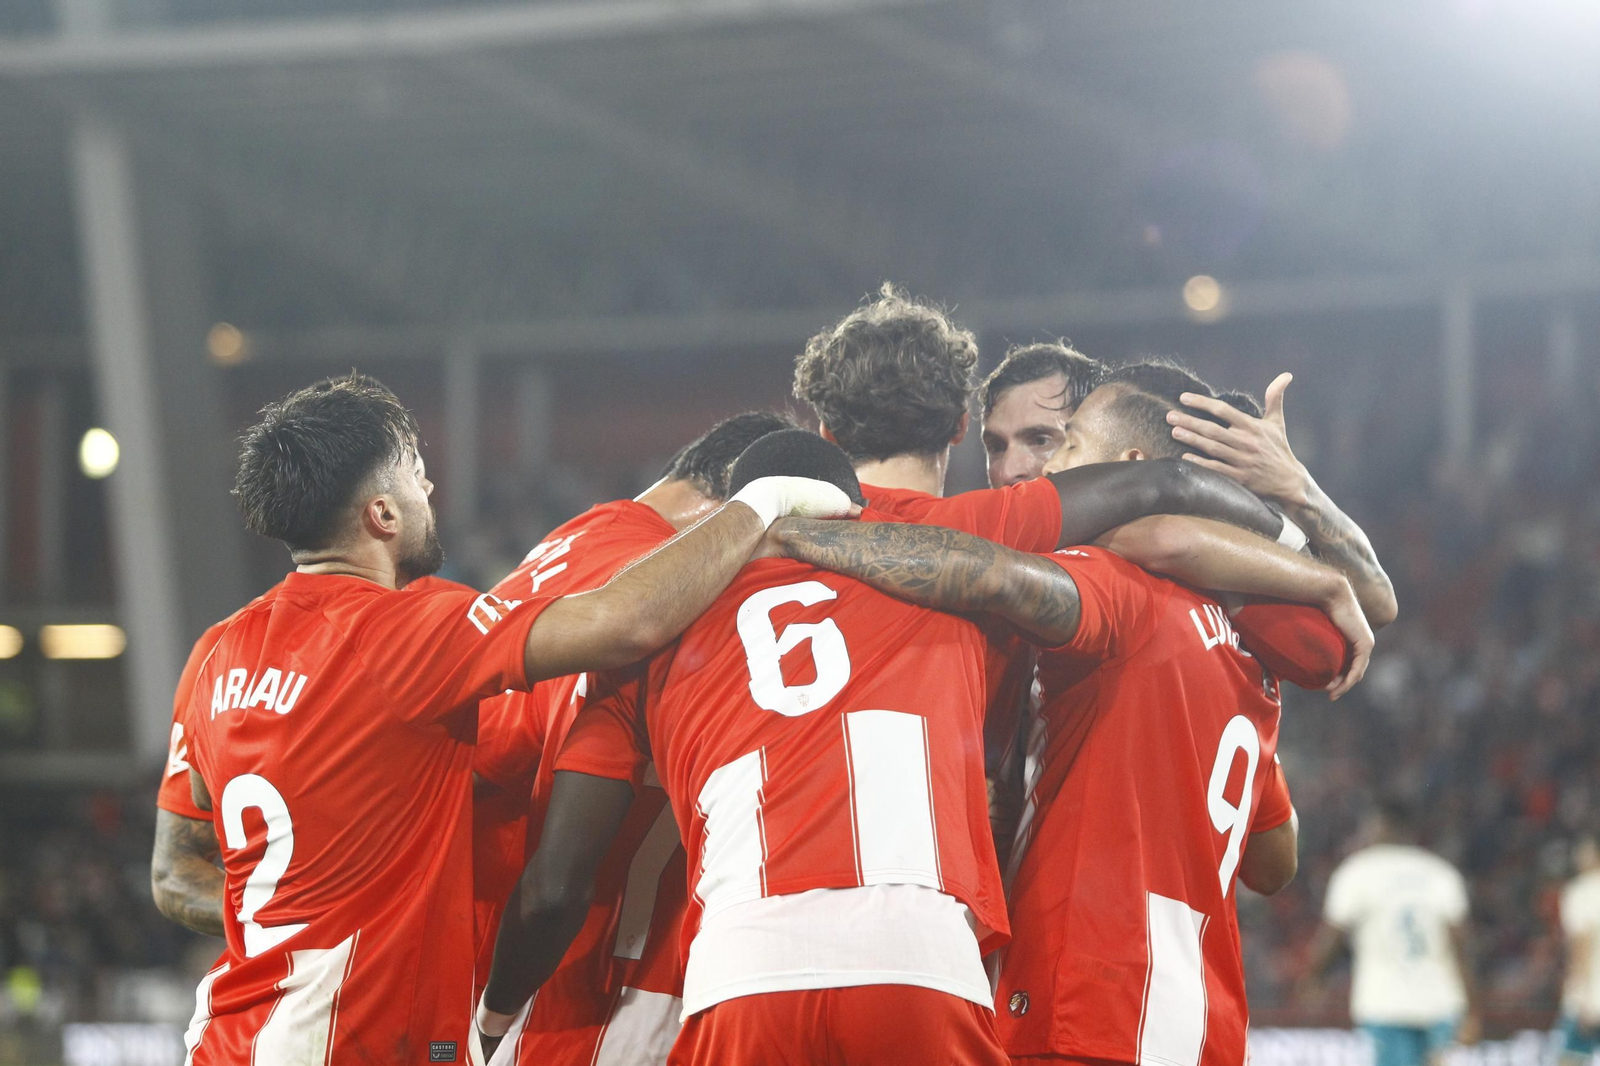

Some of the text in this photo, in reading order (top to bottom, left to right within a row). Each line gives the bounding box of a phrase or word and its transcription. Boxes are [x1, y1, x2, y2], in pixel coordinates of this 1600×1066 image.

[736, 581, 851, 717] 6
[221, 773, 309, 958] 2
[1207, 714, 1260, 899] 9
